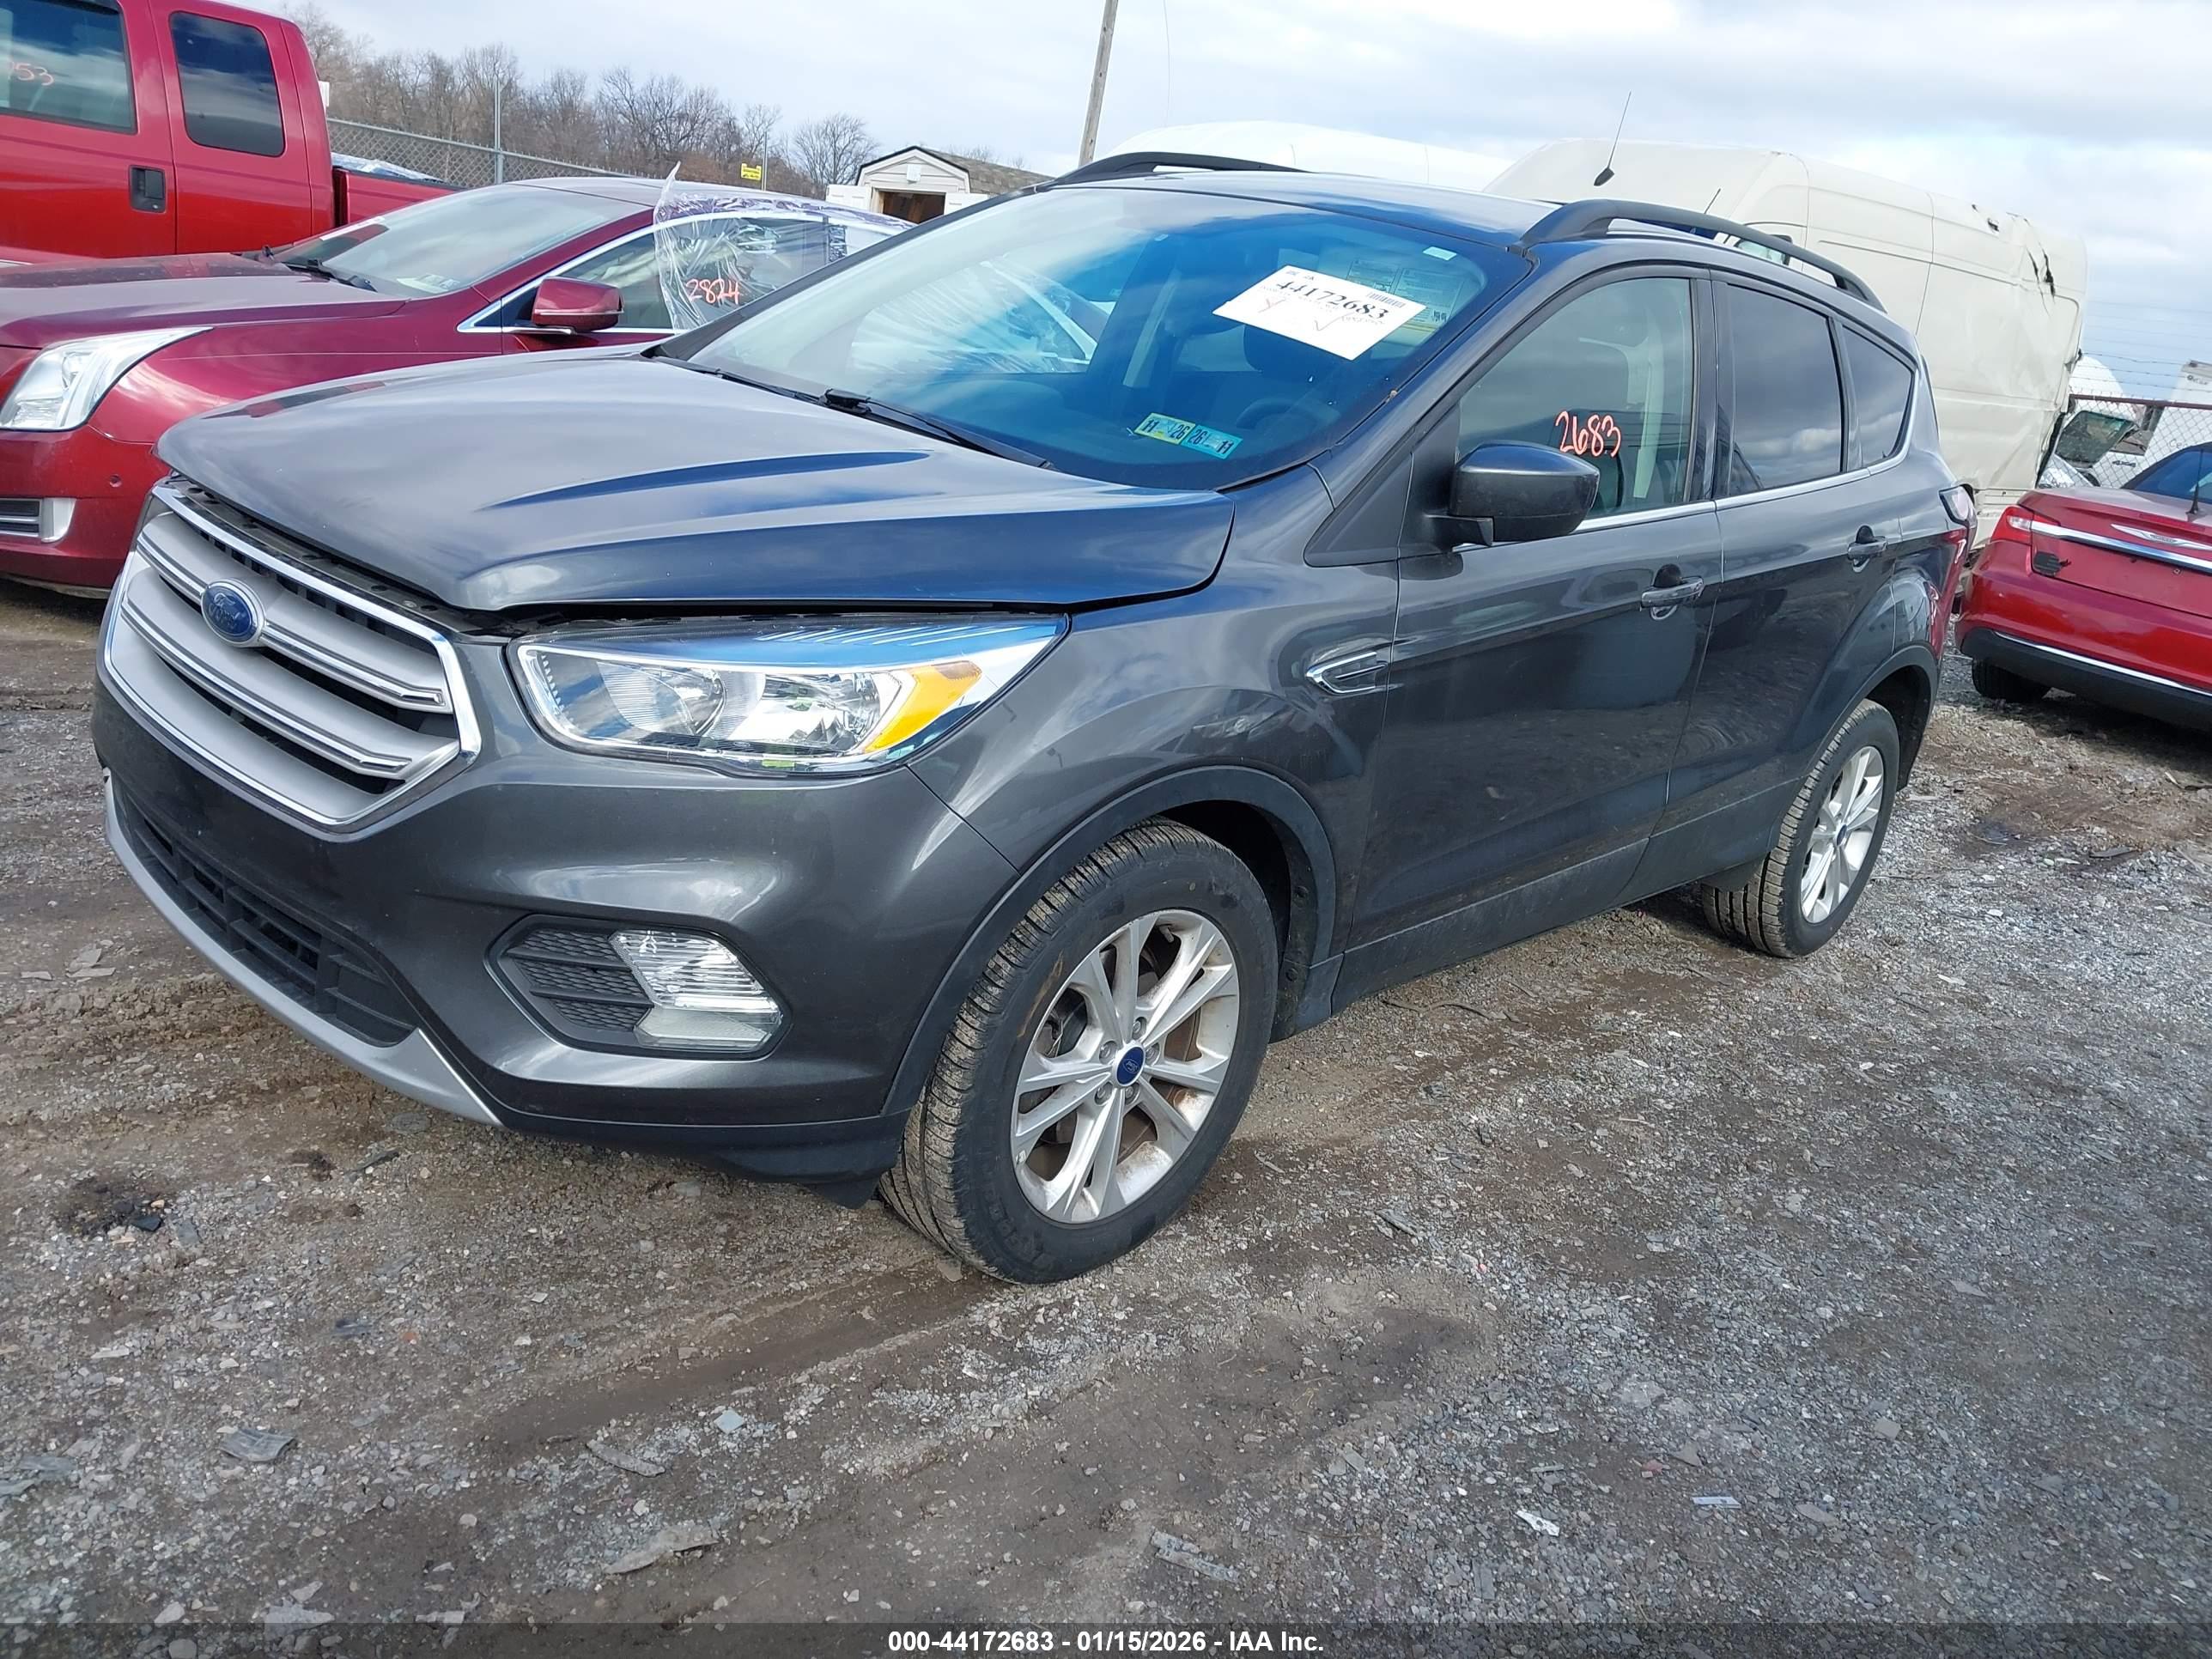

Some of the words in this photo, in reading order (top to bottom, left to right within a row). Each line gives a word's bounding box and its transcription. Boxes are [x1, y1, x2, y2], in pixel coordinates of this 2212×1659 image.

[685, 277, 740, 306] 2824
[1275, 280, 1389, 320] 44172683
[1554, 410, 1622, 458] 2683
